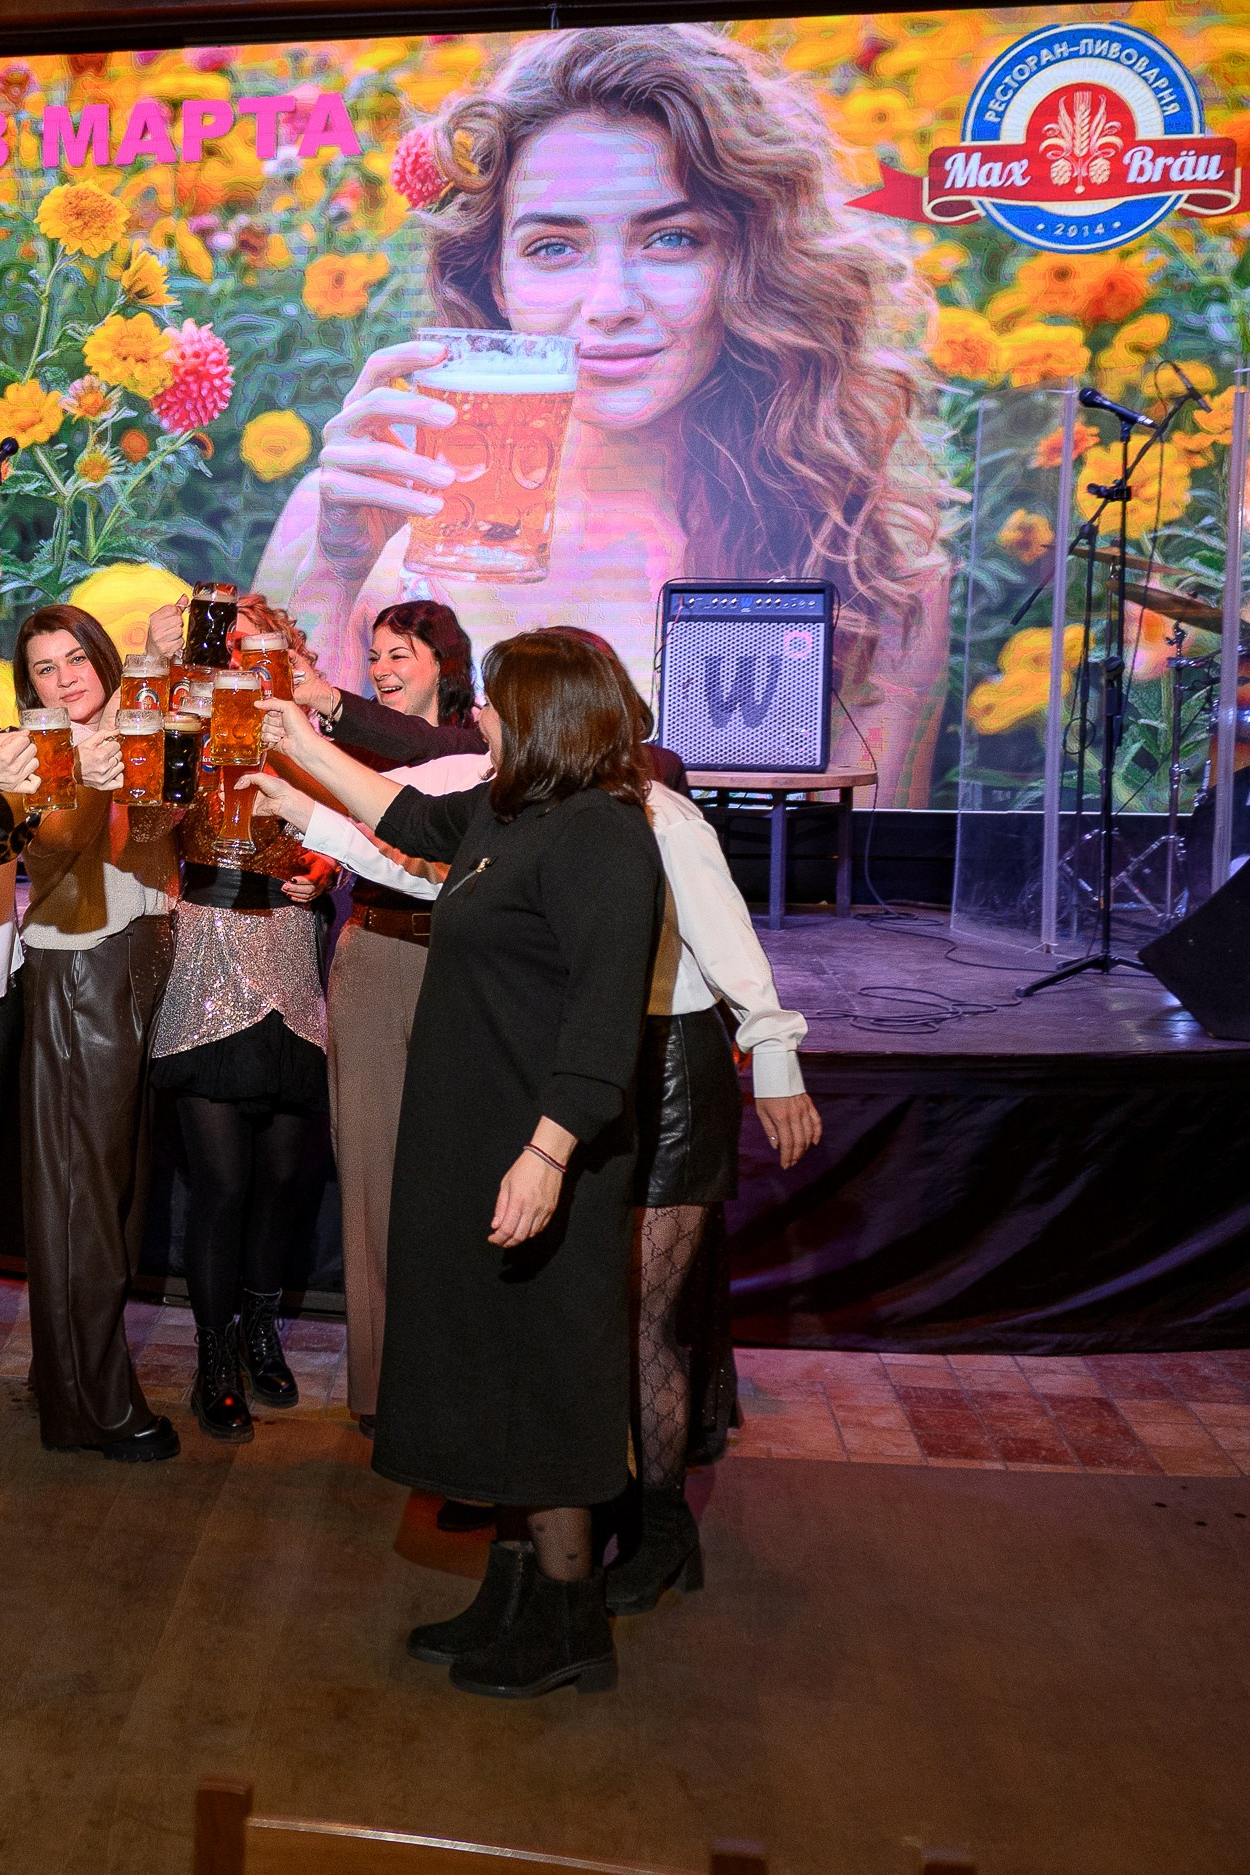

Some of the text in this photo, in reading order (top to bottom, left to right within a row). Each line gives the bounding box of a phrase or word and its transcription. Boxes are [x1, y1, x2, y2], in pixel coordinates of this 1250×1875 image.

[983, 38, 1181, 123] РЕСТОРАН-ПИВОВАРНЯ
[43, 93, 362, 168] МАРТА
[944, 146, 1225, 189] Max Bräu
[1053, 222, 1106, 239] 2014
